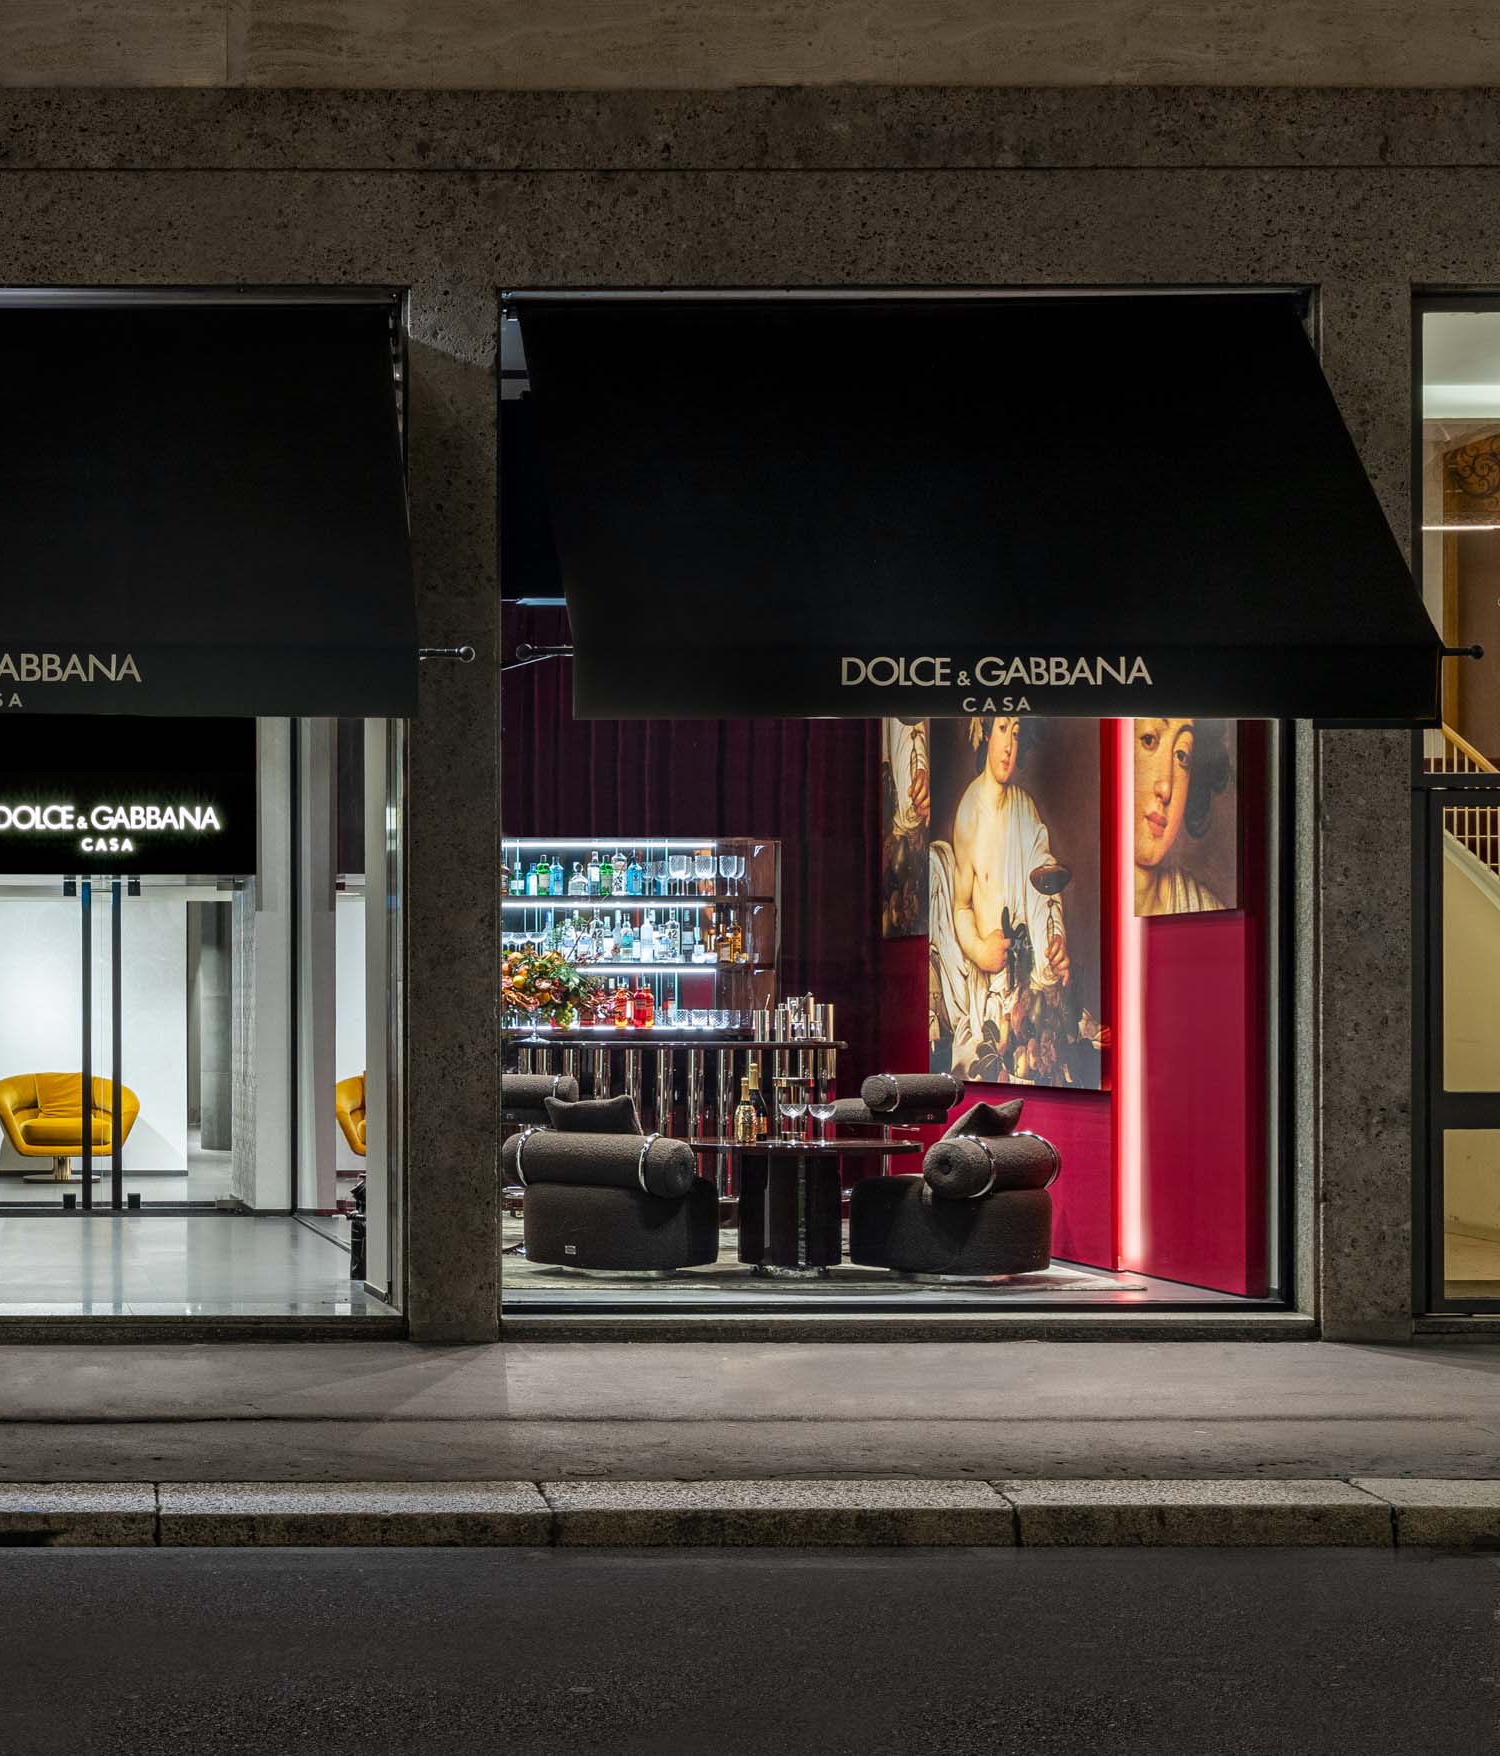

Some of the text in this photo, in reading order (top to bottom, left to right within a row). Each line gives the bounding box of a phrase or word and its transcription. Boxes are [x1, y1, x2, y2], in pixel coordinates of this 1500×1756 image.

[841, 656, 1153, 686] DOLCE & GABBANA
[962, 697, 1031, 712] CASA
[76, 815, 89, 830] &
[91, 806, 221, 830] GABBANA
[81, 837, 134, 852] CASA
